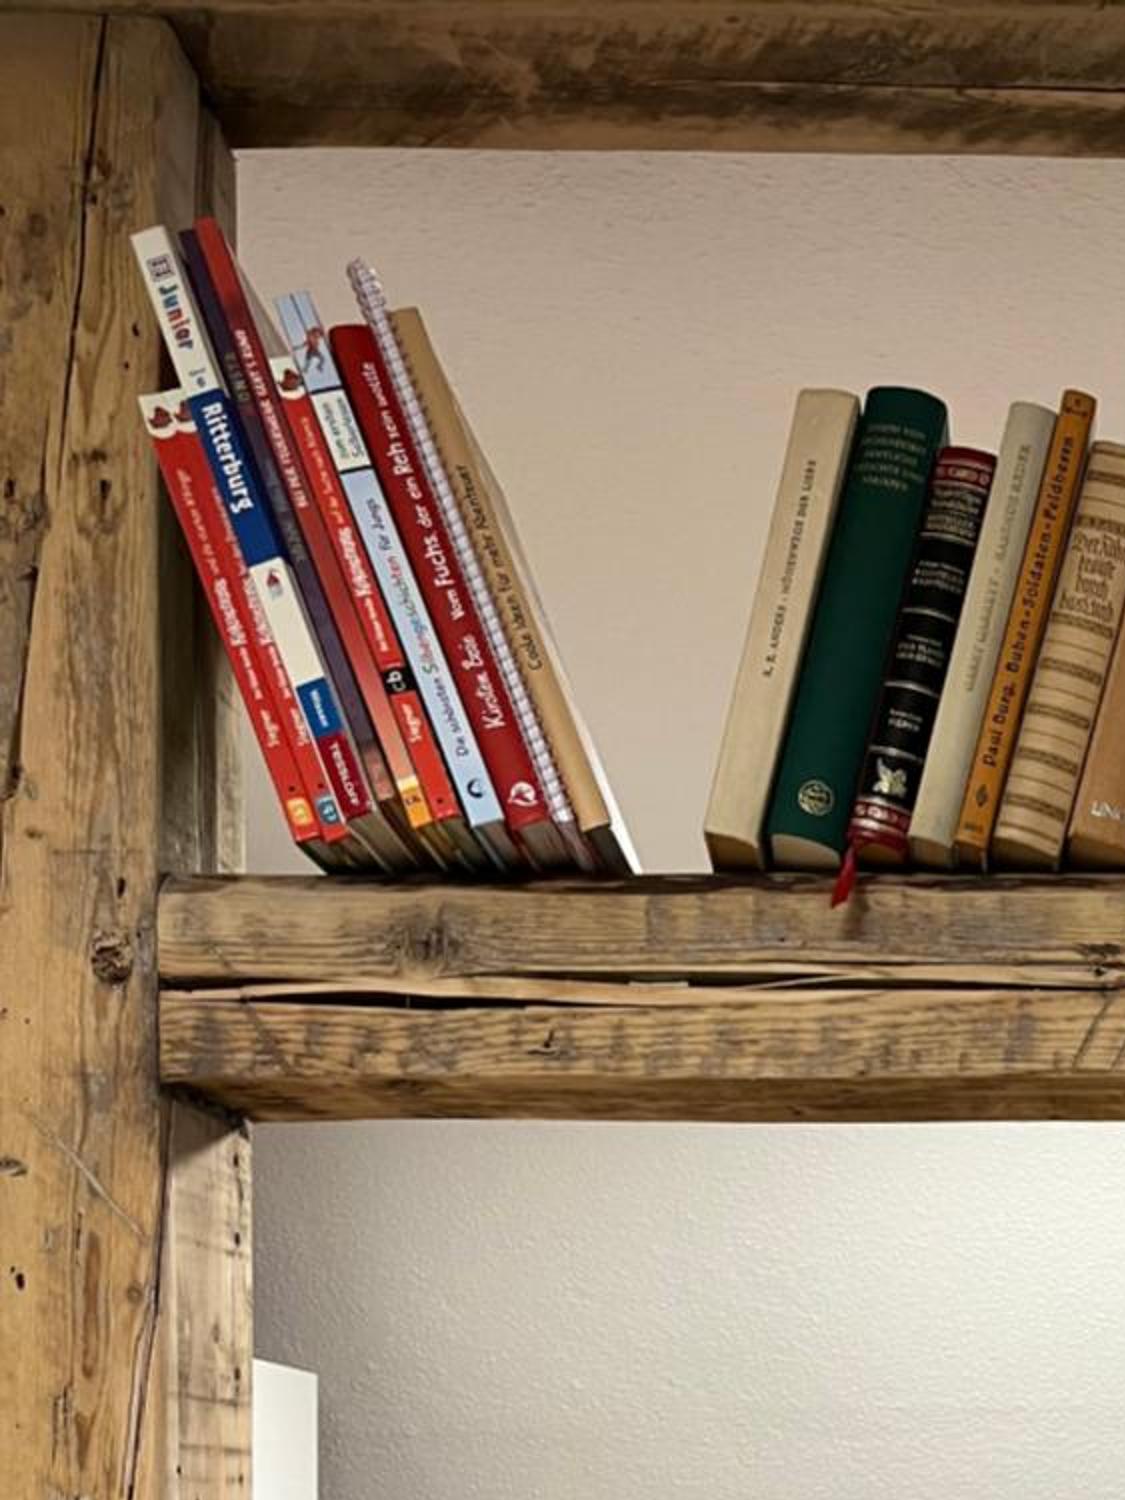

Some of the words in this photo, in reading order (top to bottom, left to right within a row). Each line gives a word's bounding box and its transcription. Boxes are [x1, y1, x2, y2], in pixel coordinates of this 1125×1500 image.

[159, 284, 193, 349] Junior
[377, 408, 401, 441] sein
[201, 401, 253, 513] Ritterburg
[384, 439, 415, 478] Reh
[402, 474, 423, 502] ein
[450, 461, 491, 532] Abenteuer
[411, 502, 433, 530] der
[479, 530, 505, 569] mehr
[492, 567, 515, 595] für
[442, 586, 466, 620] Vom
[516, 631, 545, 672] Coole
[465, 669, 507, 733] Kirsten
[980, 728, 1005, 767] Paul
[325, 739, 363, 807] TESSLOFF
